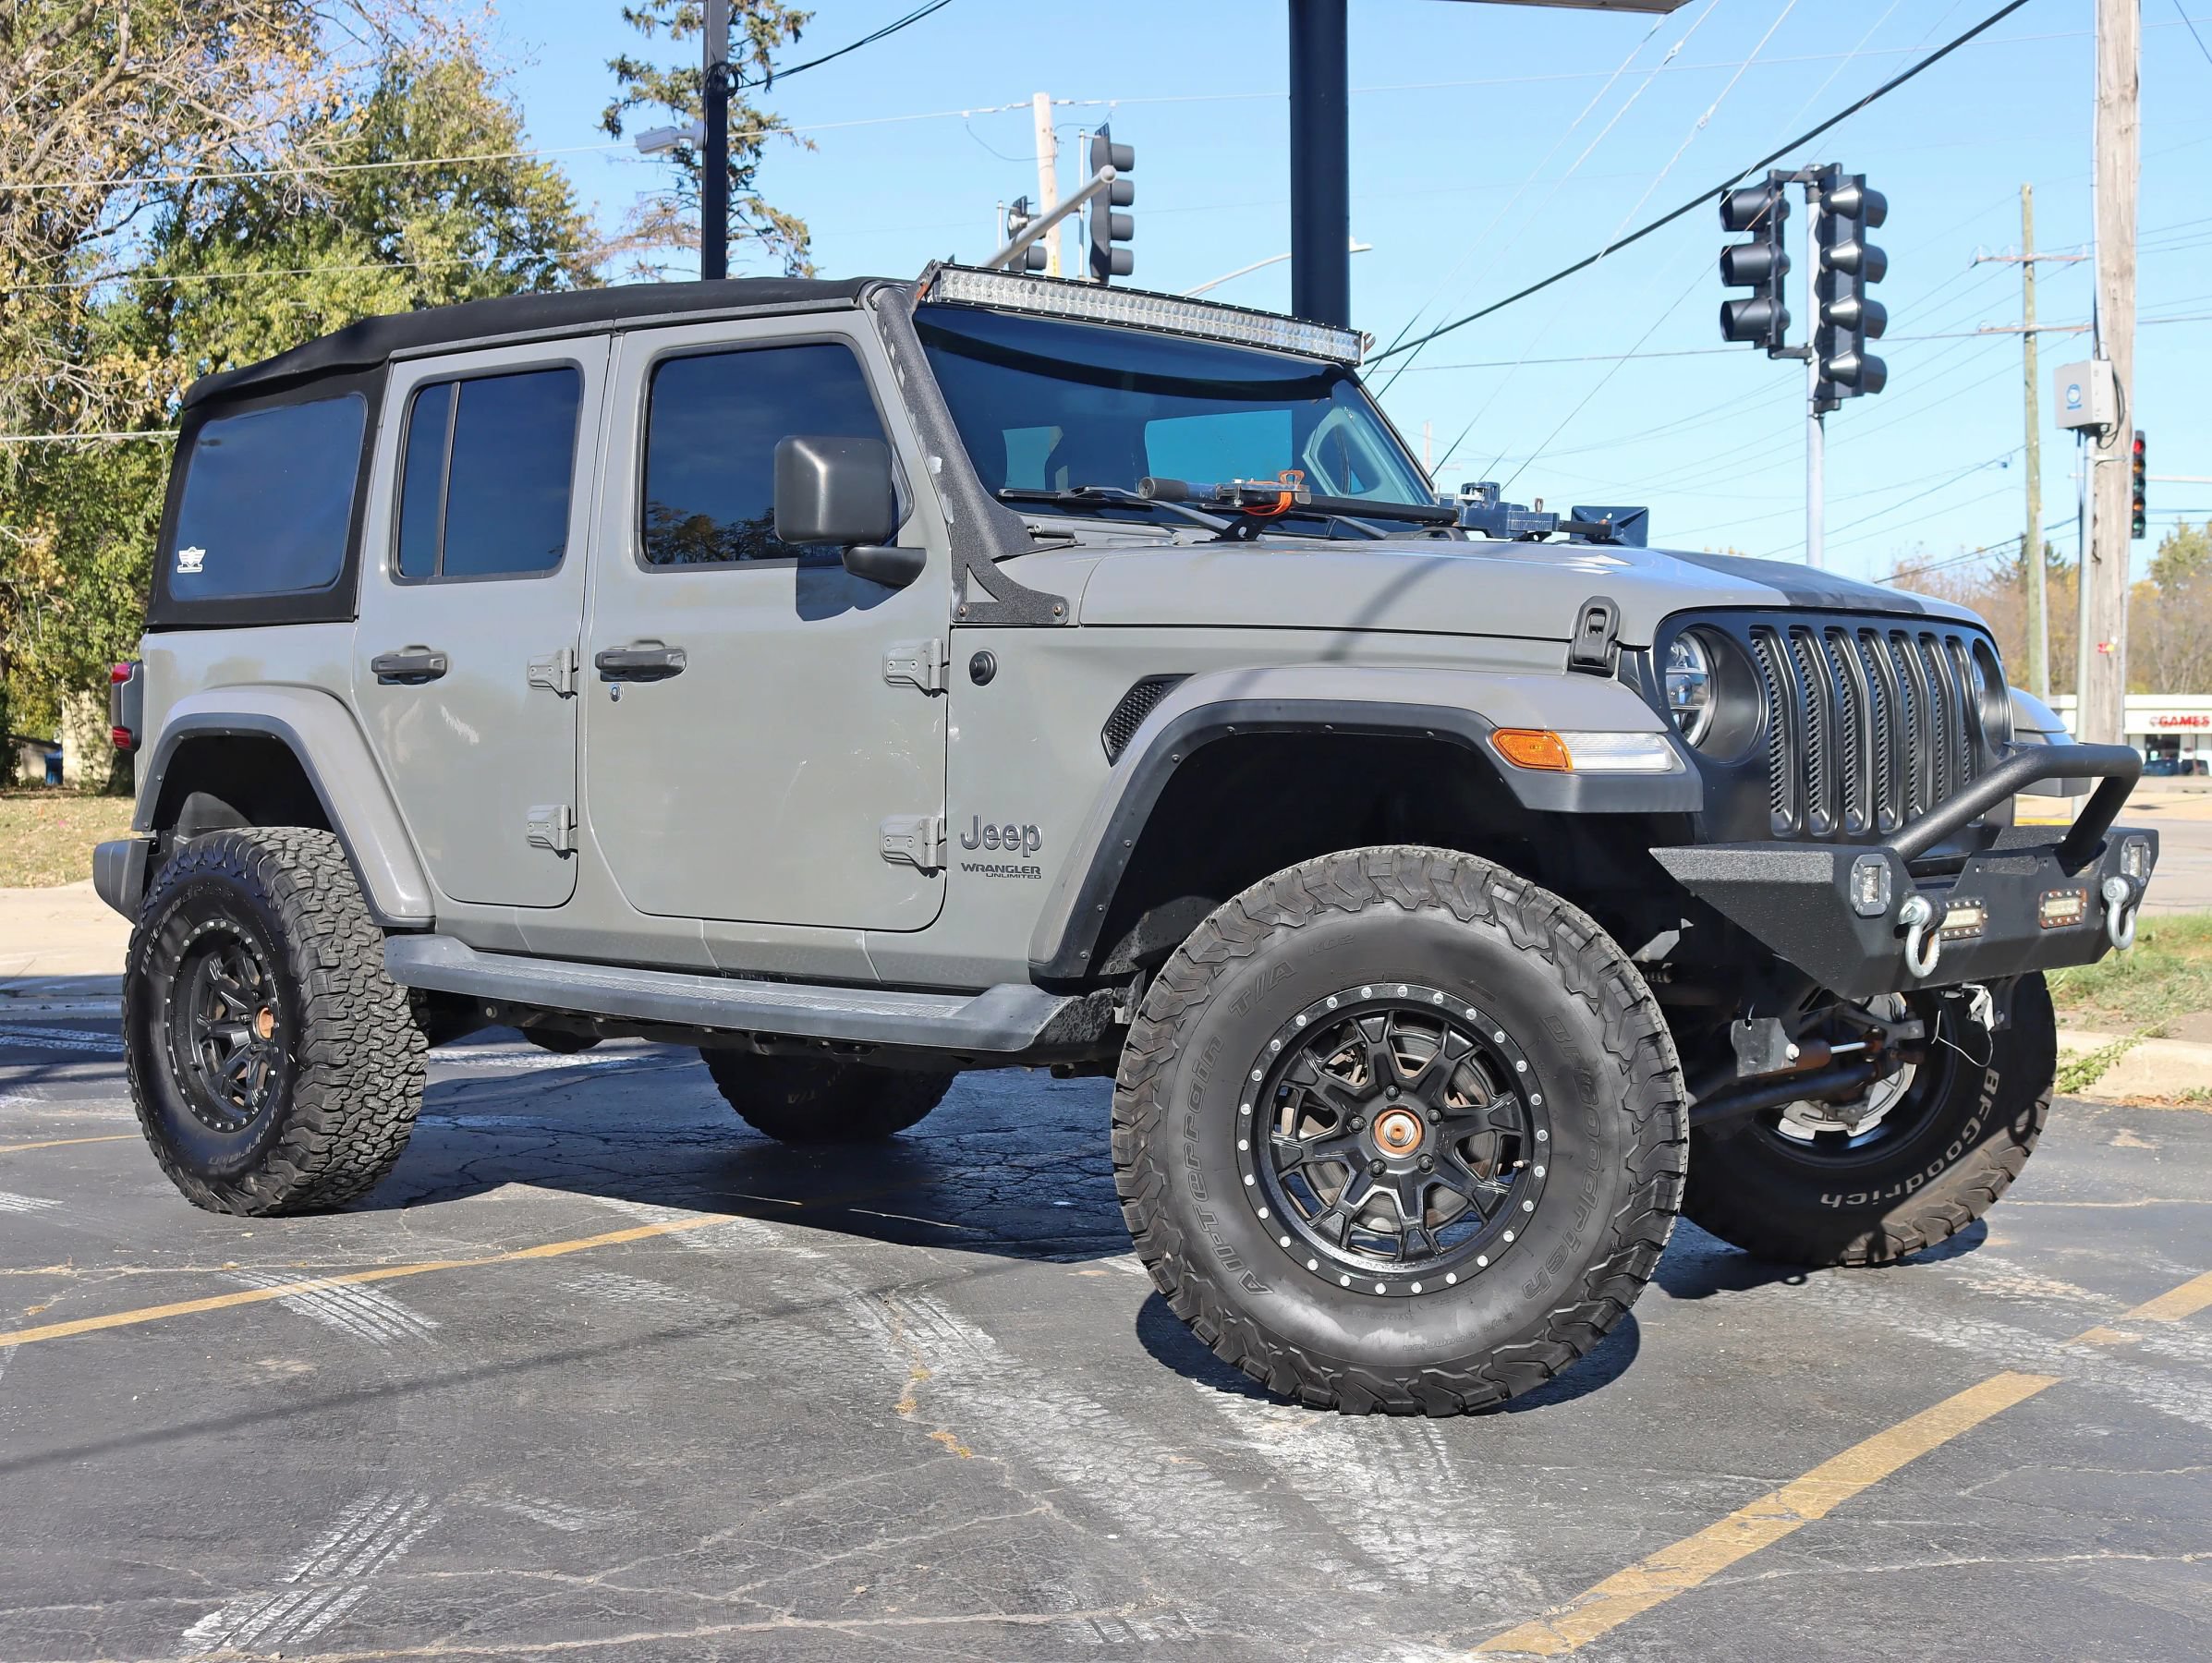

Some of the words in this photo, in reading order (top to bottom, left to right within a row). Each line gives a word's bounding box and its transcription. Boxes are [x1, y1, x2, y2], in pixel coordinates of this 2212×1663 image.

[2158, 715, 2210, 728] GAMES
[960, 814, 1042, 858] Jeep
[961, 862, 1040, 875] WRANGLER
[1228, 960, 1297, 1017] T/A
[1184, 1035, 1274, 1295] All-Terrain
[1523, 1014, 1601, 1300] BFGoodrich
[1820, 1068, 2000, 1208] BFGoodrich
